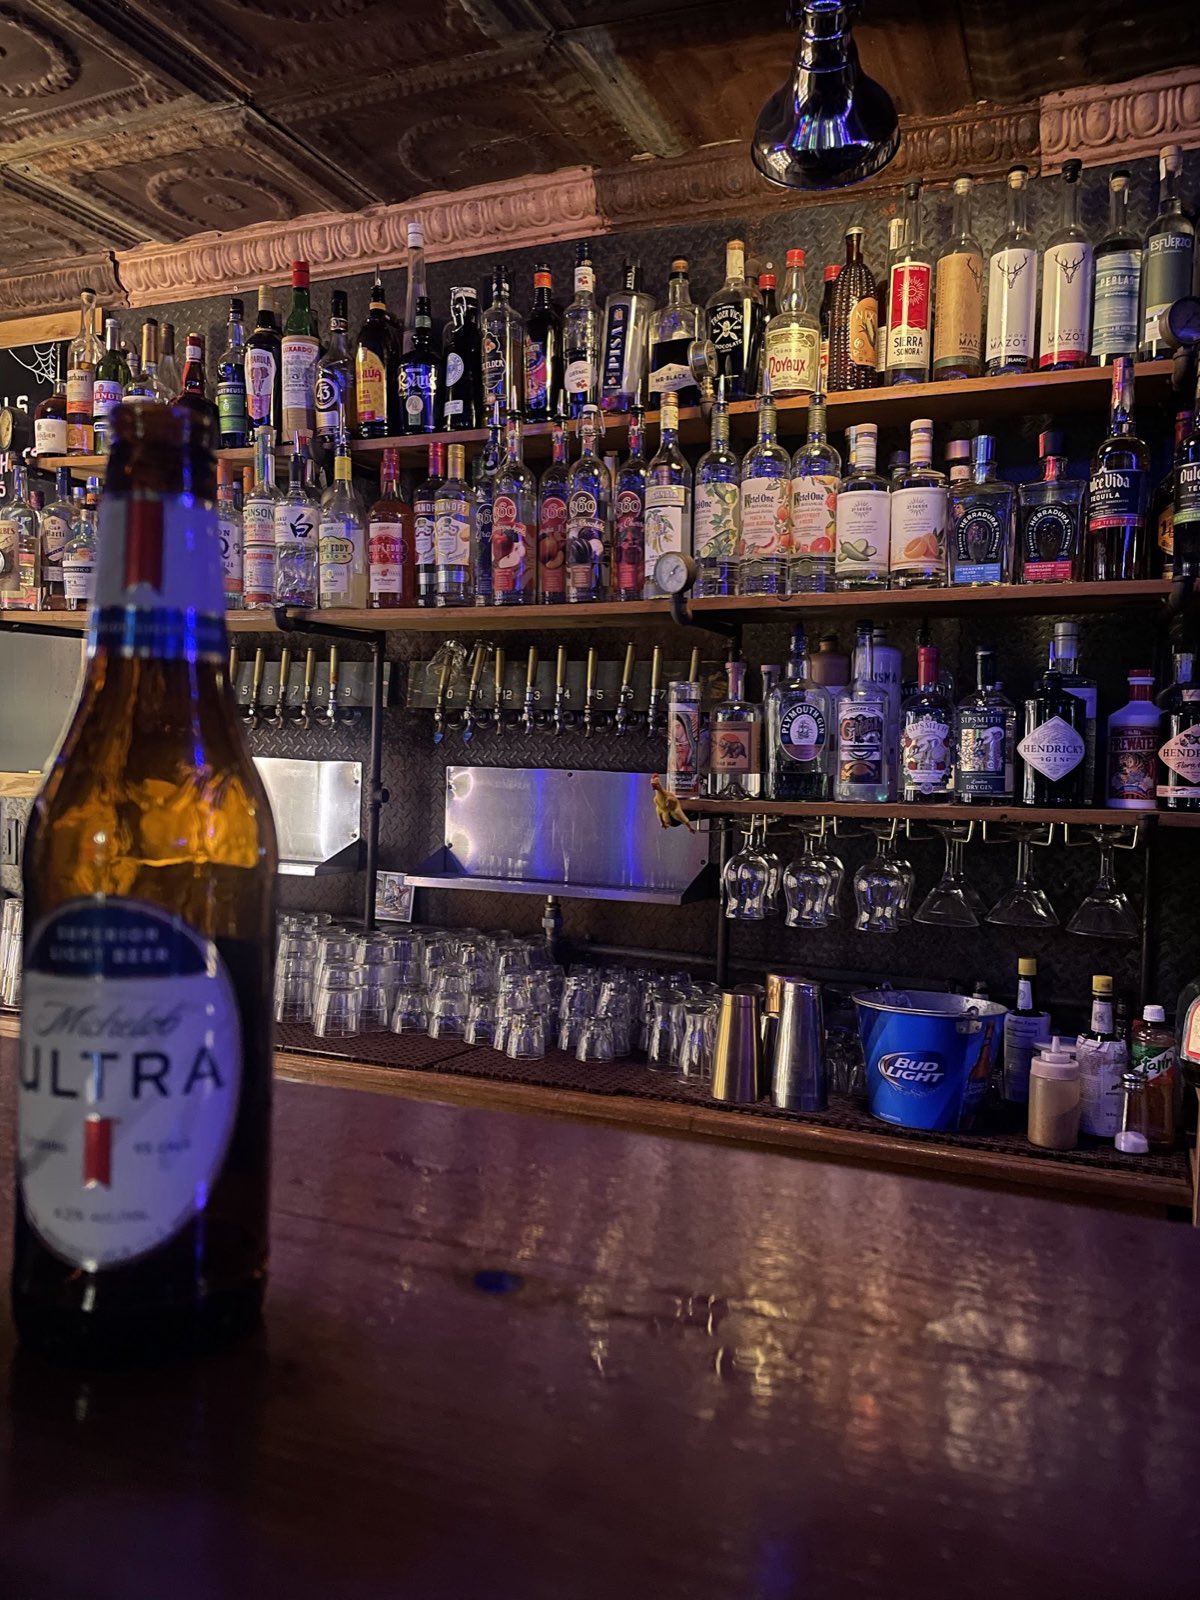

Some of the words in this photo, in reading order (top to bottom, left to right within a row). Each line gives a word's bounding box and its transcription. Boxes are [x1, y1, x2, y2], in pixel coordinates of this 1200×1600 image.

[894, 336, 923, 348] SIERRA
[990, 339, 1027, 350] MAZOT
[317, 382, 331, 400] 43
[1104, 473, 1130, 489] Vida
[744, 494, 760, 509] Ketel
[760, 494, 775, 503] One
[794, 492, 810, 508] Ketel
[810, 491, 825, 501] One
[1090, 492, 1120, 502] TEQUILA
[570, 496, 595, 518] 360
[960, 510, 999, 530] HERRADURA
[1029, 508, 1070, 528] HERRADURA
[331, 544, 350, 552] EDDY
[242, 686, 249, 695] 5
[267, 686, 274, 695] 6
[293, 686, 300, 696] 7
[317, 687, 324, 696] 8
[345, 687, 352, 697] 9
[781, 705, 820, 736] PLYMOUTH
[817, 716, 826, 735] GIN
[961, 716, 1002, 725] SIPSMITH
[908, 721, 948, 734] SIPSMITH
[1023, 743, 1083, 755] HENDRICK'S
[894, 1057, 939, 1072] BUD
[20, 1042, 226, 1101] ULTRA
[885, 1066, 945, 1083] LIGHT
